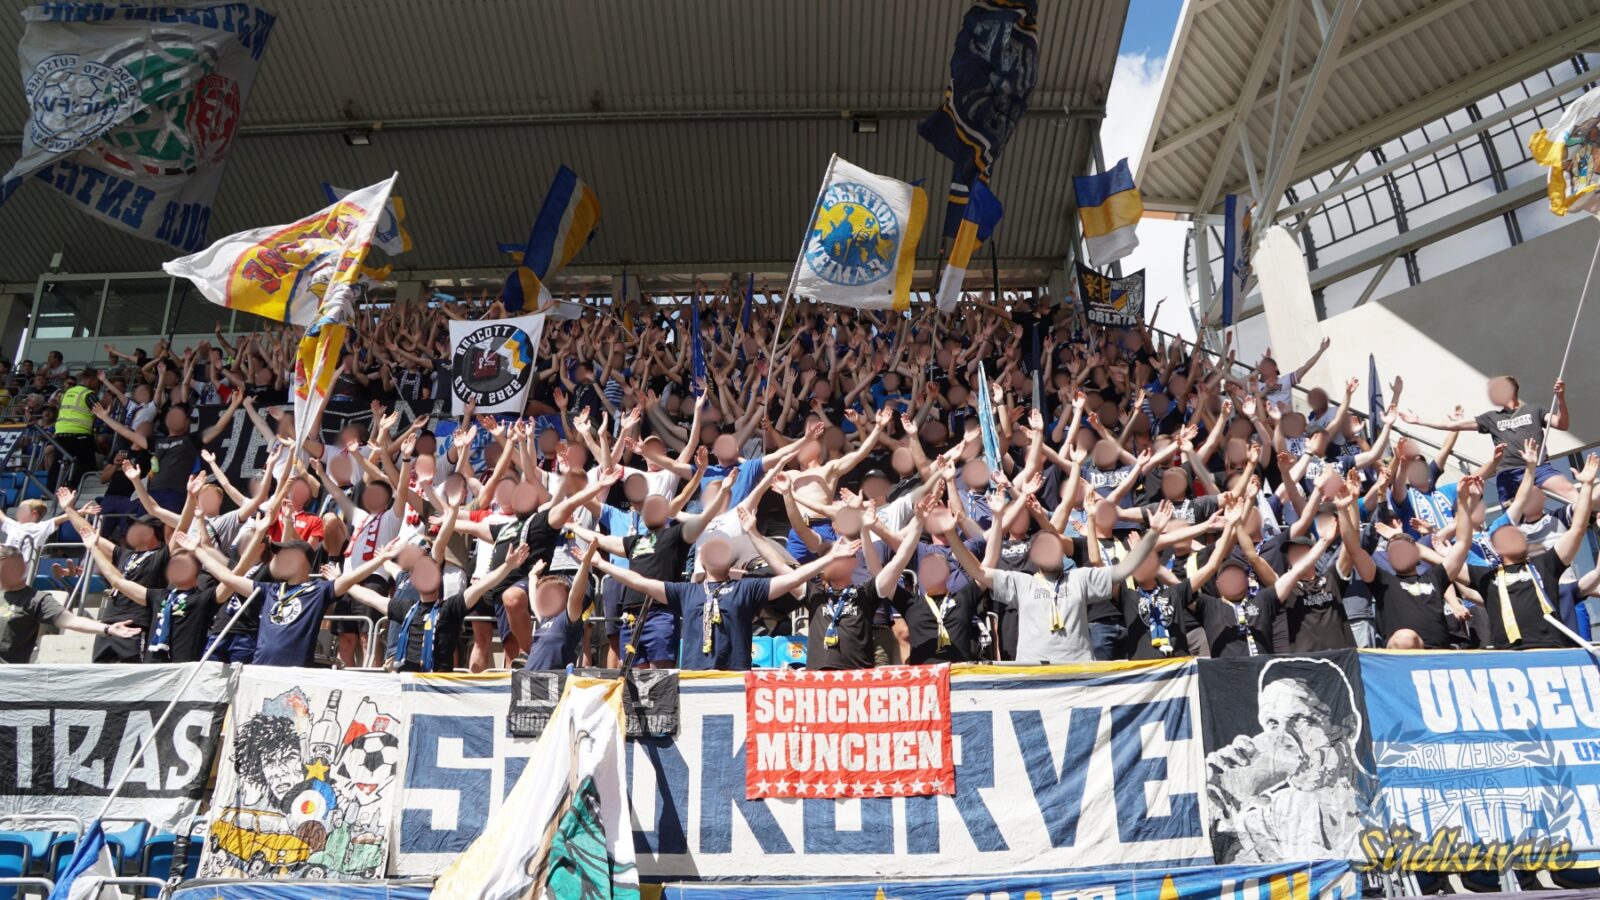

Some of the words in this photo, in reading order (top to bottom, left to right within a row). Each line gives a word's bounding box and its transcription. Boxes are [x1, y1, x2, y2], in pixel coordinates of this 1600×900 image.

[806, 237, 888, 282] WEIMAR
[47, 283, 55, 292] 7
[456, 326, 511, 356] BOYCOTT
[454, 376, 483, 404] QATAR
[488, 381, 522, 404] 2022
[755, 684, 941, 723] SCHICKERIA
[1411, 665, 1600, 734] UNBEU
[757, 725, 943, 772] MÜNCHEN
[400, 697, 1203, 854] SDKRVE
